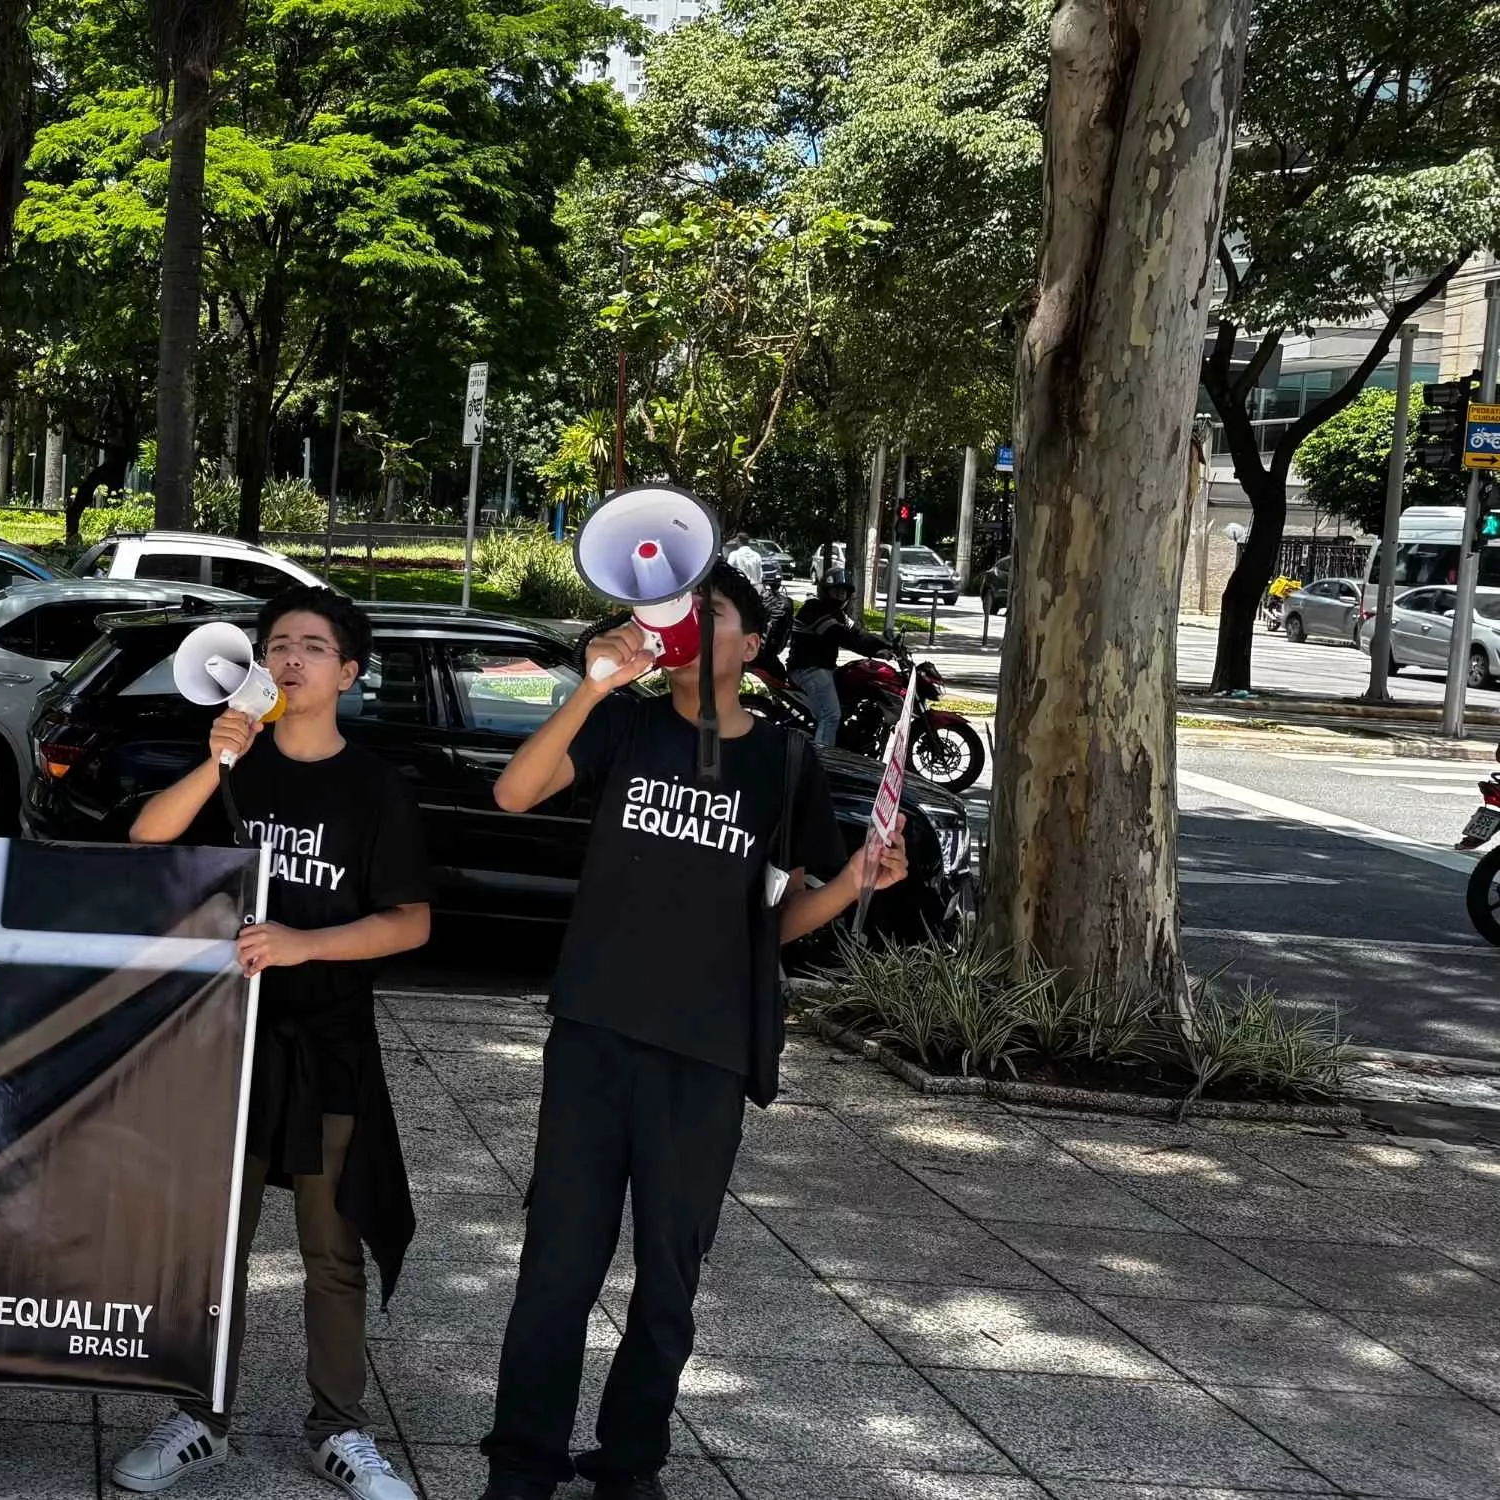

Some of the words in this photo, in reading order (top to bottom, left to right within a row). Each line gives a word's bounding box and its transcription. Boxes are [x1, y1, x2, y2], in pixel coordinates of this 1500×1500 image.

[627, 775, 740, 823] animal
[622, 803, 756, 858] EQUALITY
[68, 1335, 149, 1358] BRASIL
